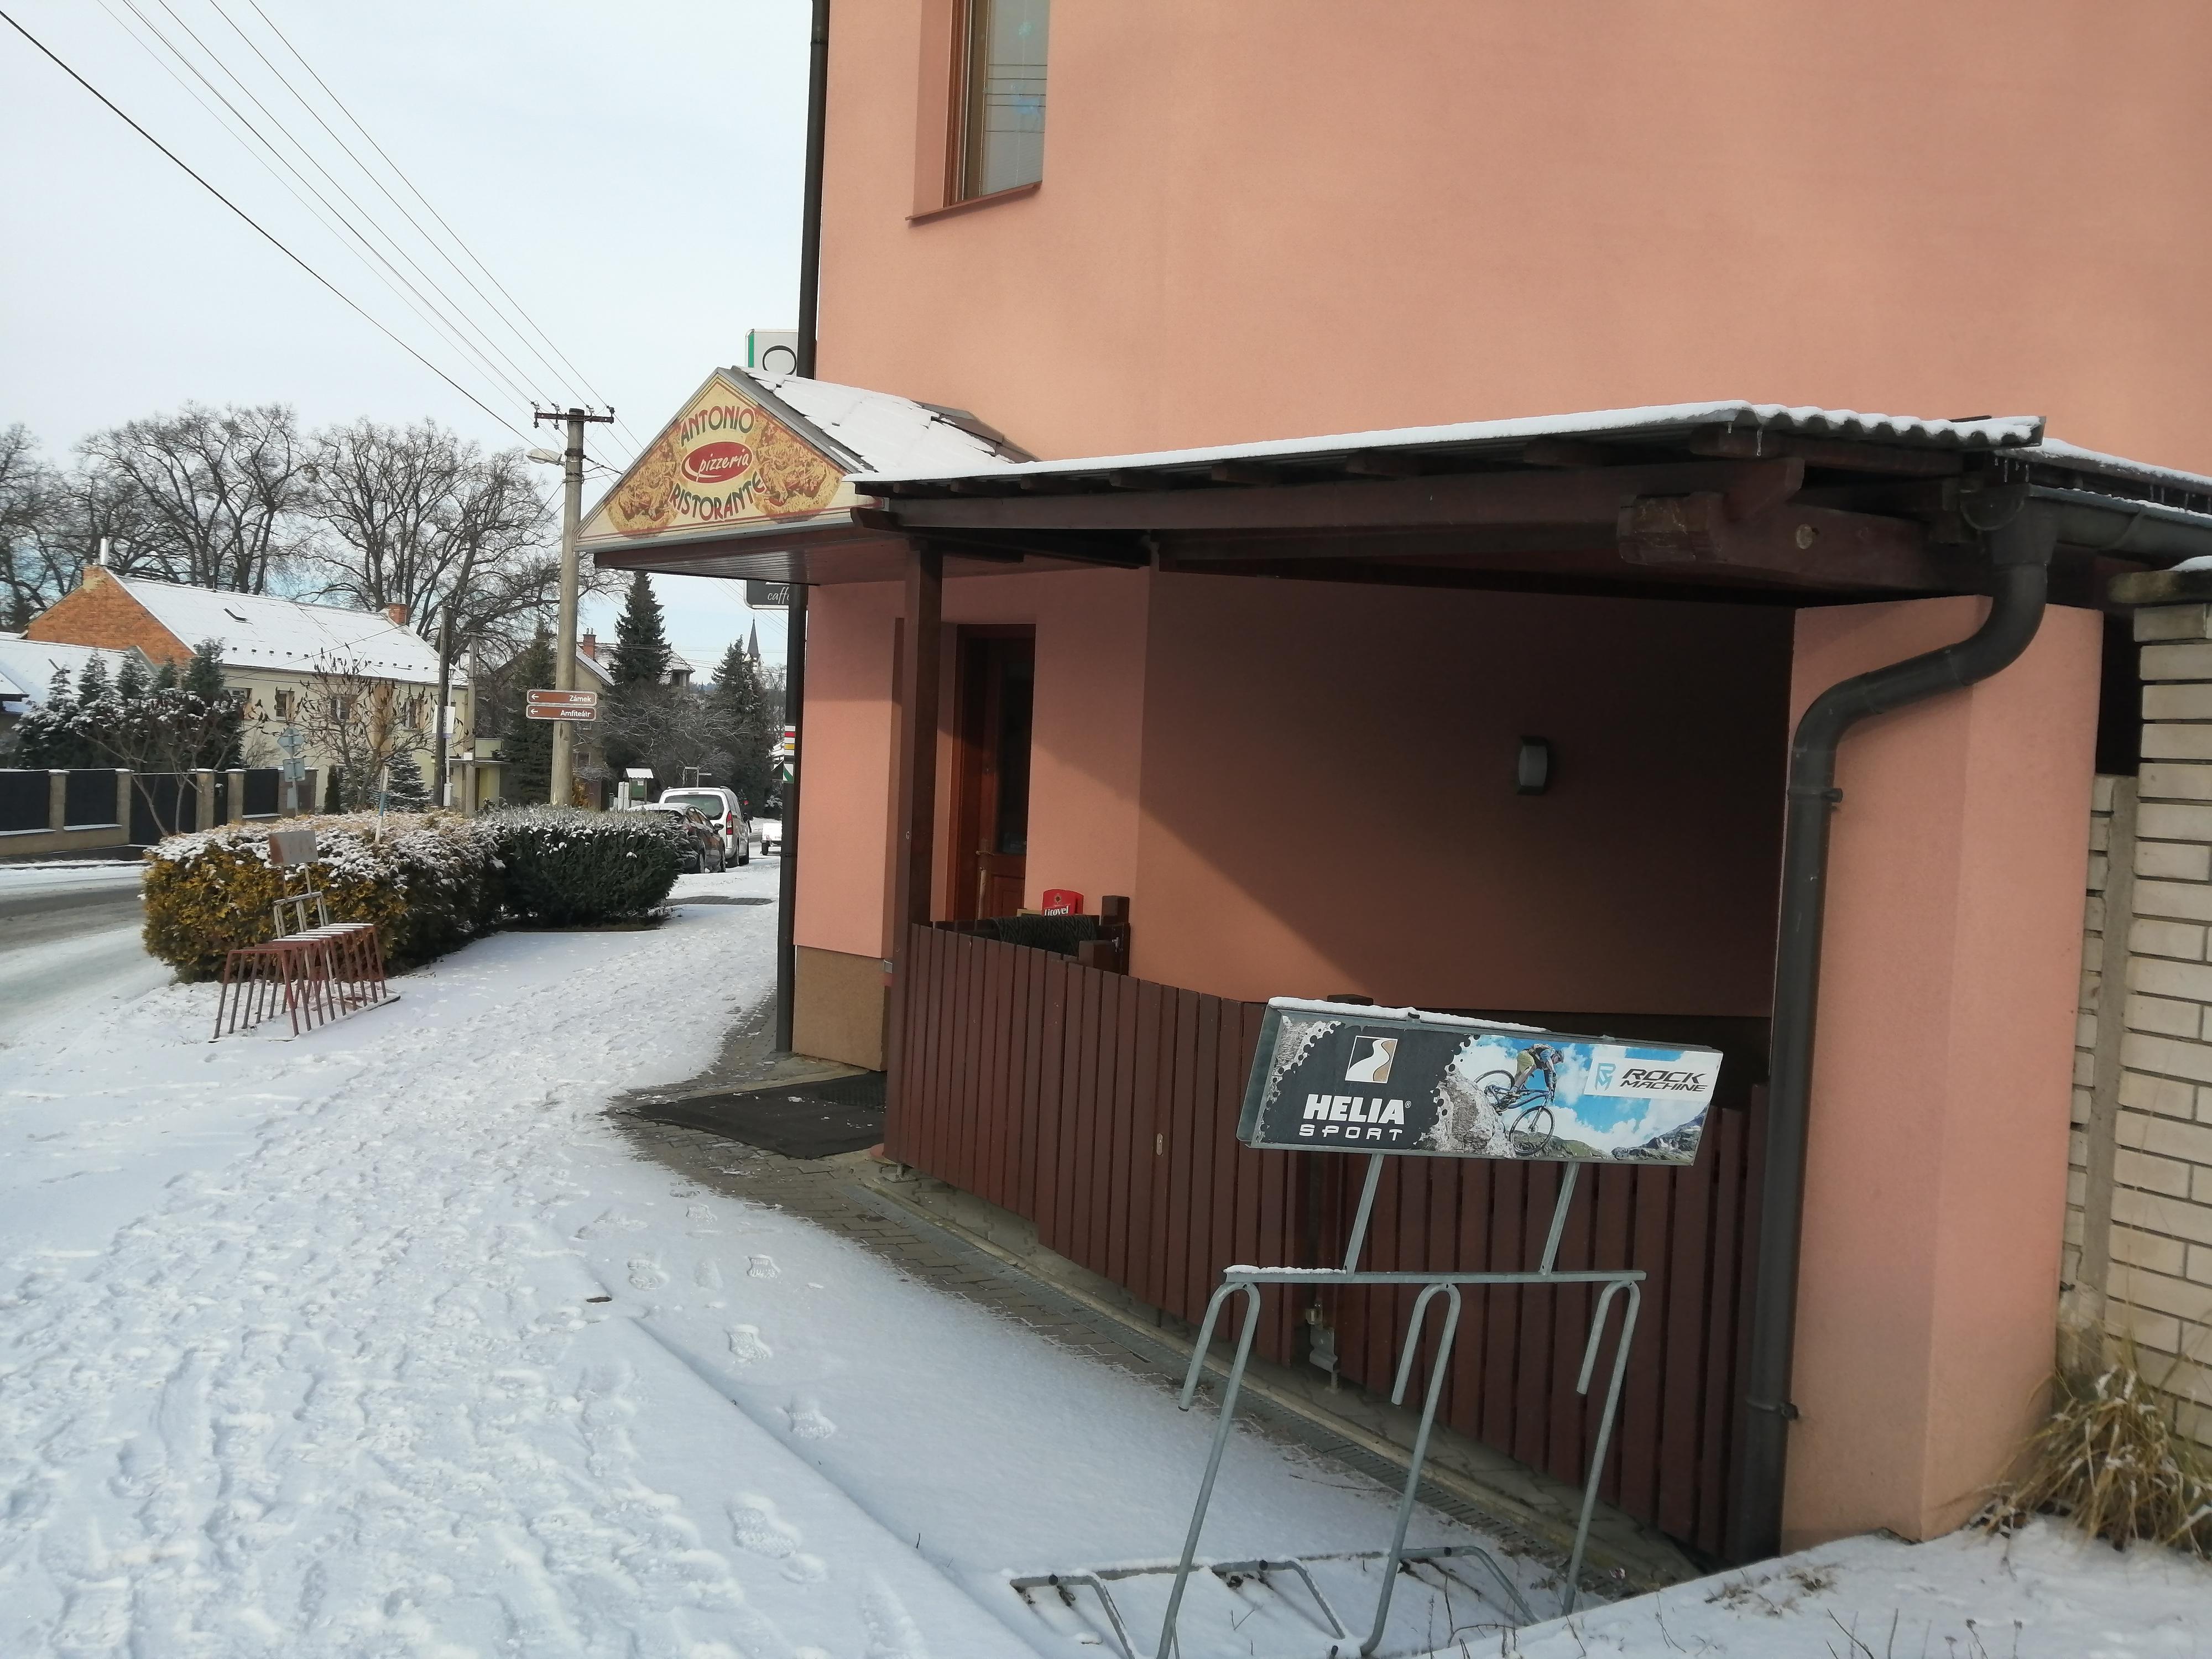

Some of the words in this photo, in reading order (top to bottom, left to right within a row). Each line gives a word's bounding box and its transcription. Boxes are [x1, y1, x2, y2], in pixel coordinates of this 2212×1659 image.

[681, 405, 754, 447] ANTONIO
[696, 448, 749, 482] pizzeria
[669, 470, 766, 521] RISTORANTE
[560, 709, 592, 718] Amfiteátr
[1621, 1068, 1708, 1084] ROCK
[1620, 1080, 1708, 1092] MACHINE
[1299, 1124, 1403, 1141] SPORT
